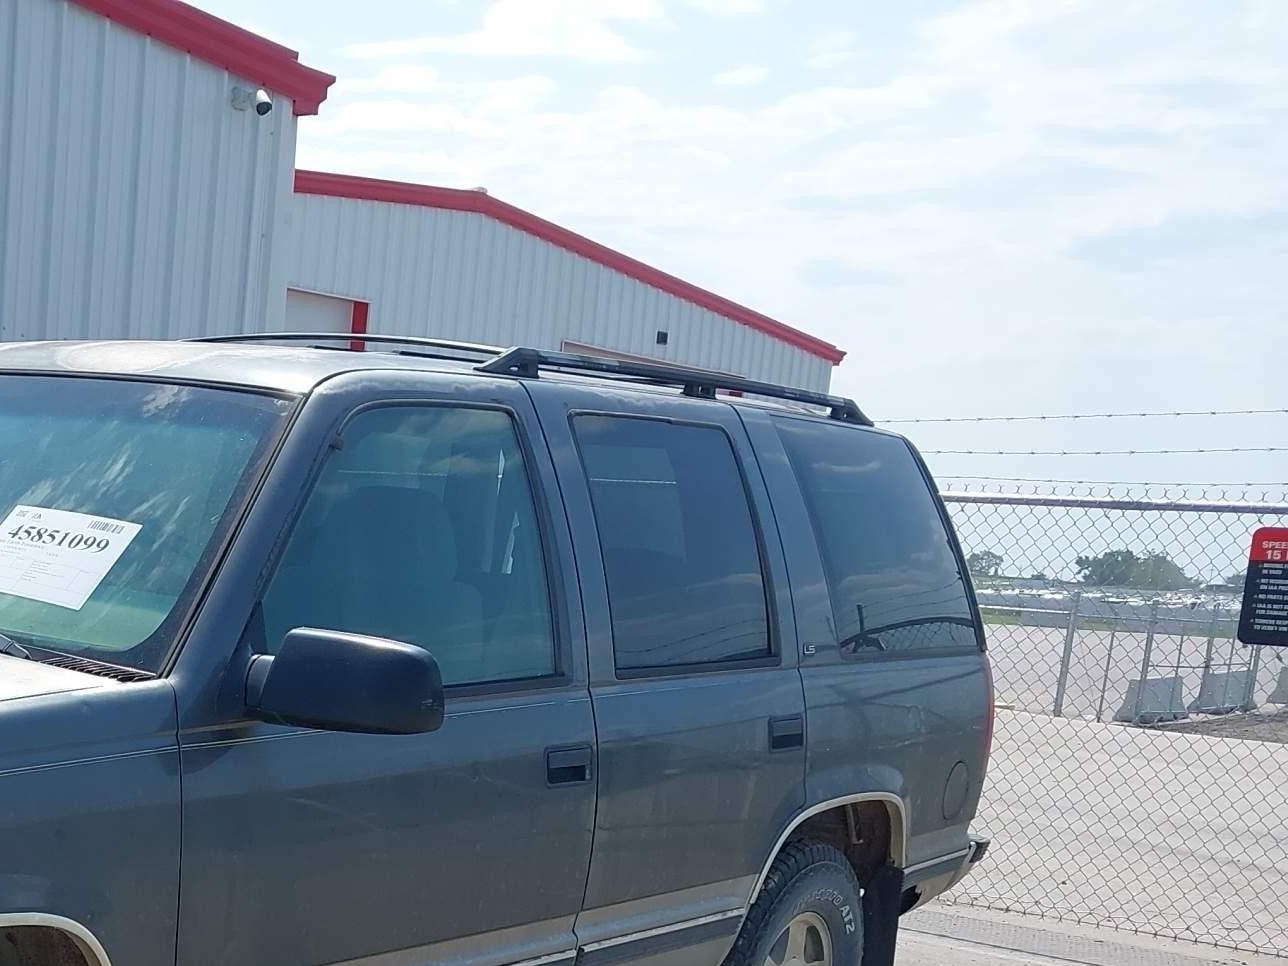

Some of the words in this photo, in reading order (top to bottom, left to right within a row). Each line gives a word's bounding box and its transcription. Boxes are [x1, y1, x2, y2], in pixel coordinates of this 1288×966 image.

[8, 524, 110, 553] 45851099
[1266, 550, 1281, 560] 15
[804, 643, 816, 655] LS
